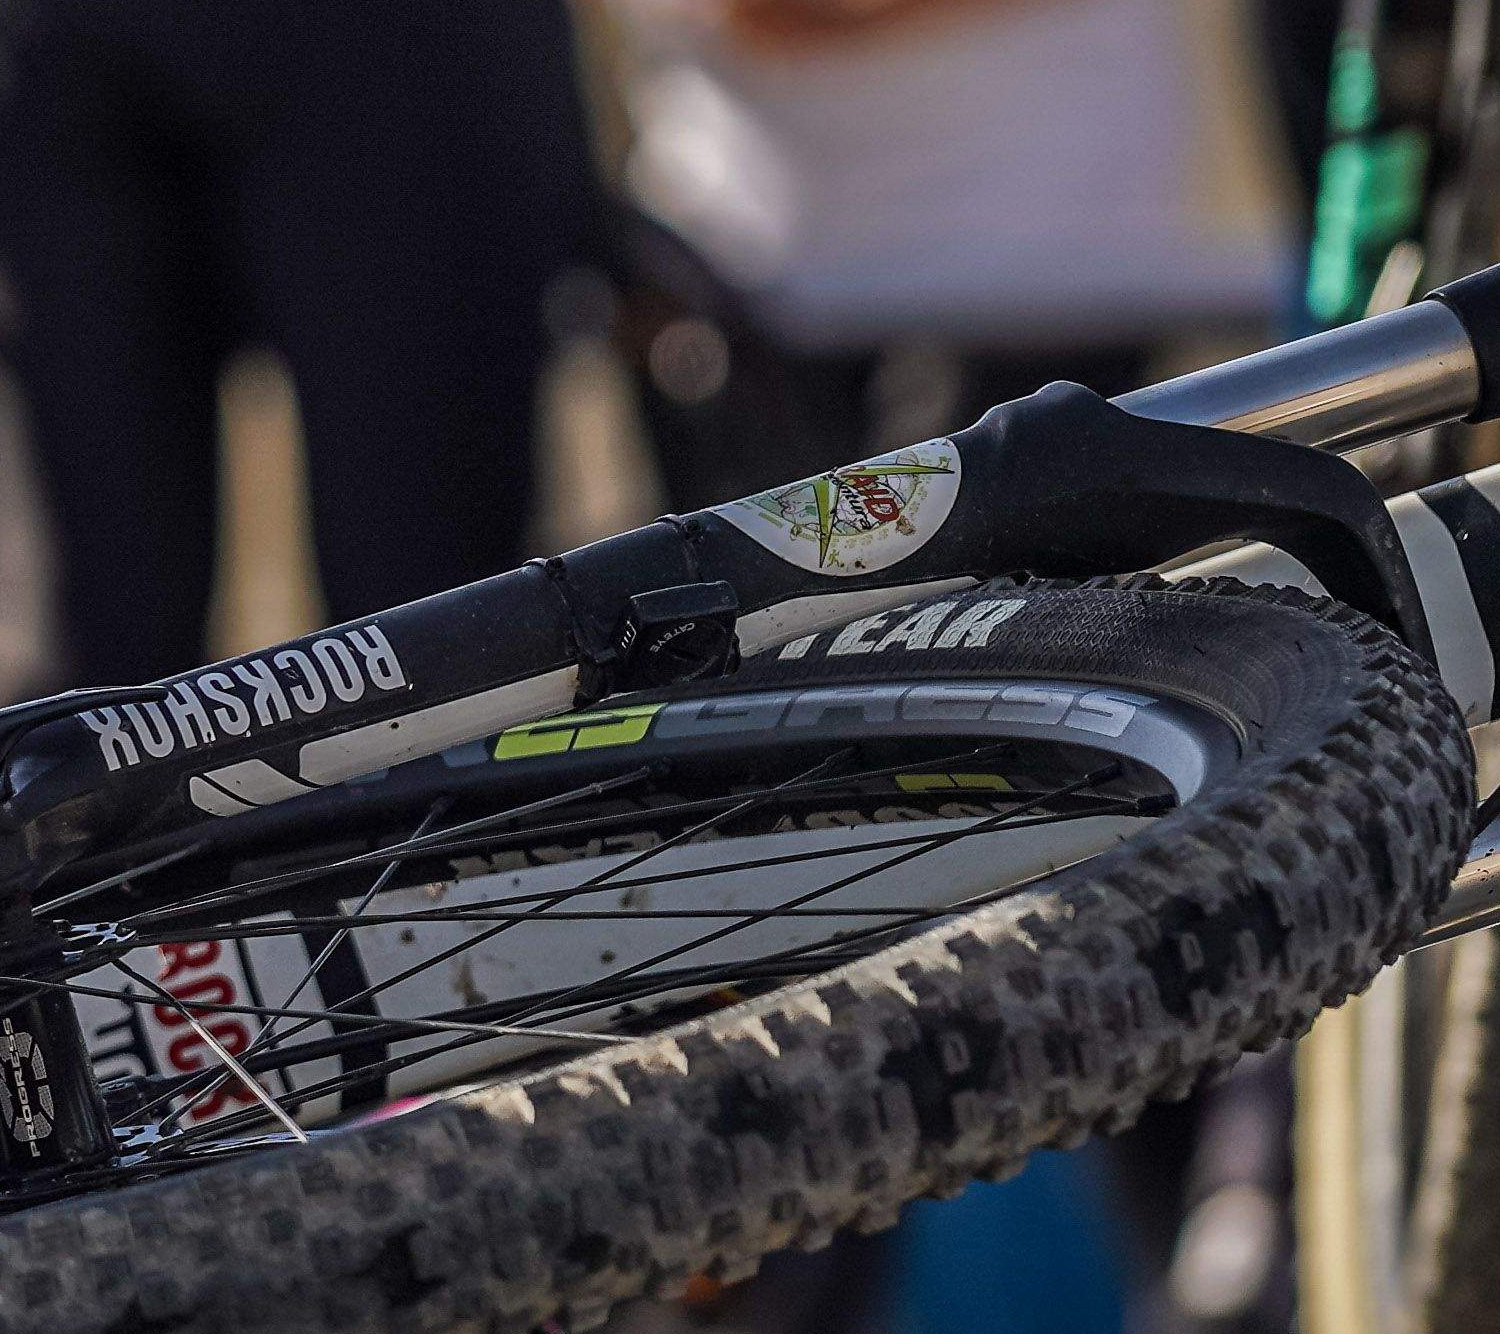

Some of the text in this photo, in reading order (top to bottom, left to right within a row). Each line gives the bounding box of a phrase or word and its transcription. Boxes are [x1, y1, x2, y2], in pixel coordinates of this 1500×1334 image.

[80, 624, 405, 772] ROCKSHOX
[649, 622, 695, 652] CATEYE
[2, 1017, 41, 1157] PROGRESS
